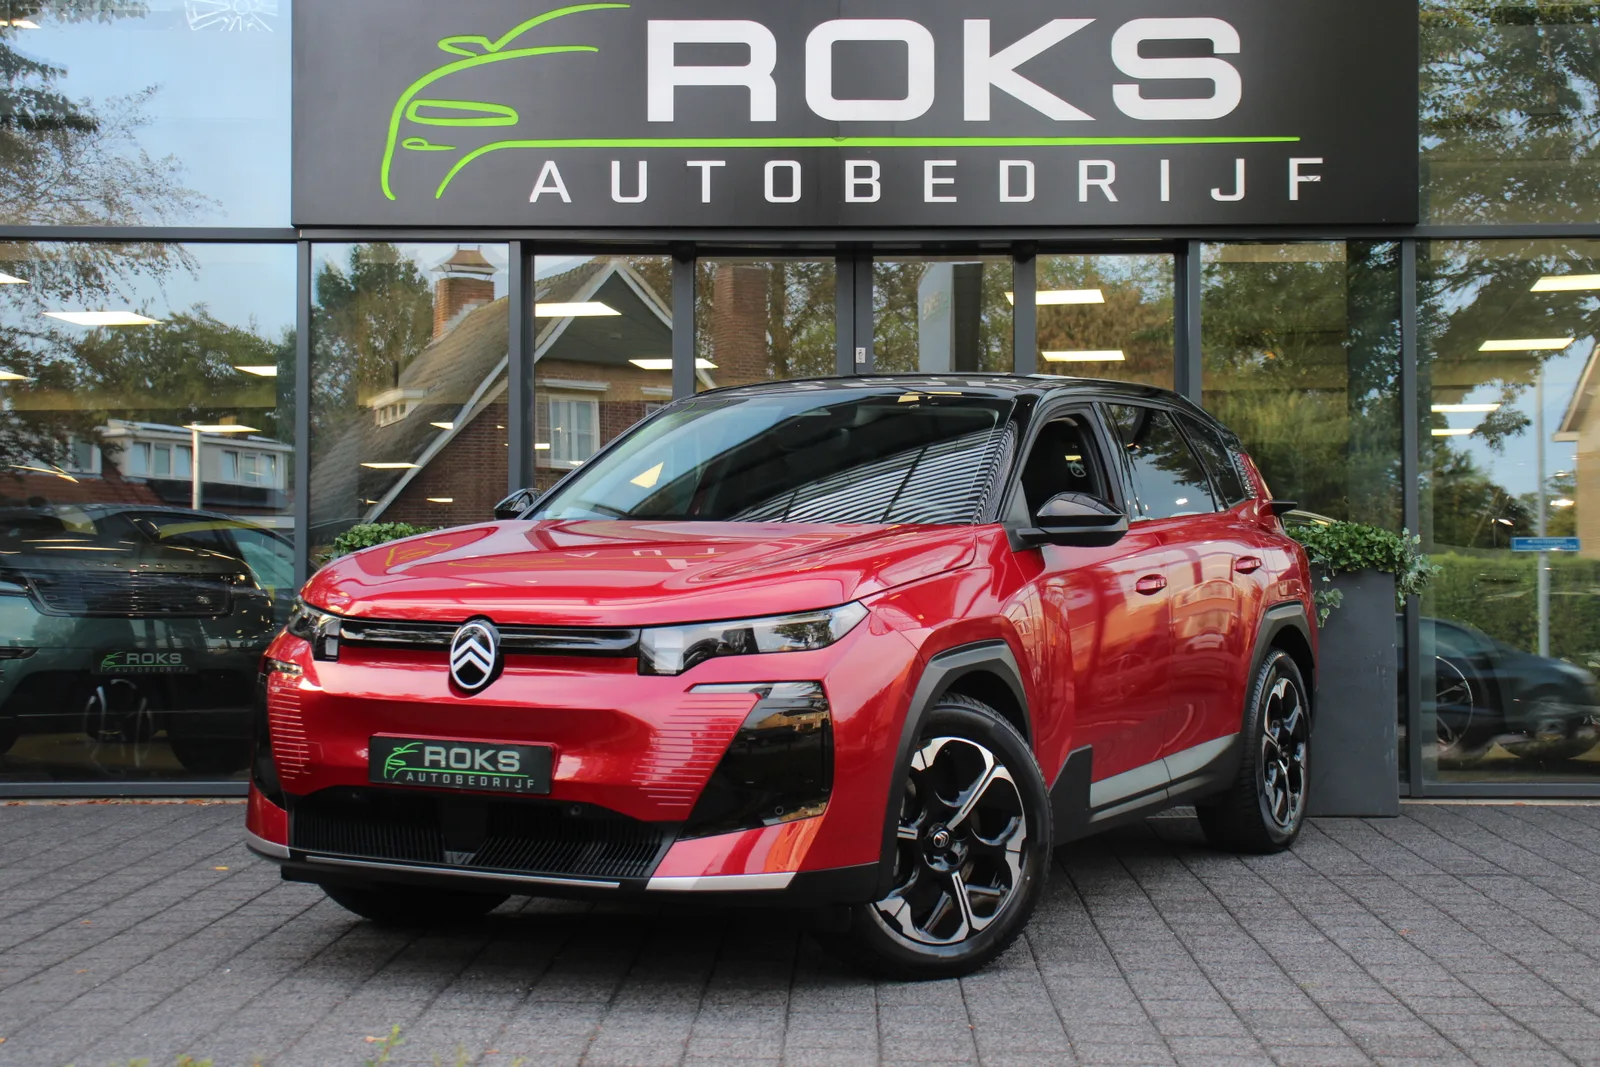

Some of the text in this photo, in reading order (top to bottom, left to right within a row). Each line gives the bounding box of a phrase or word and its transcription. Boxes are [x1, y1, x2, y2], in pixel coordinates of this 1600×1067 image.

[647, 17, 1242, 123] ROKS
[529, 157, 1324, 204] AUTOBEDRIJF
[126, 652, 182, 665] ROKS
[424, 746, 521, 772] ROKS
[406, 773, 535, 789] AUTOBEDRIJF
